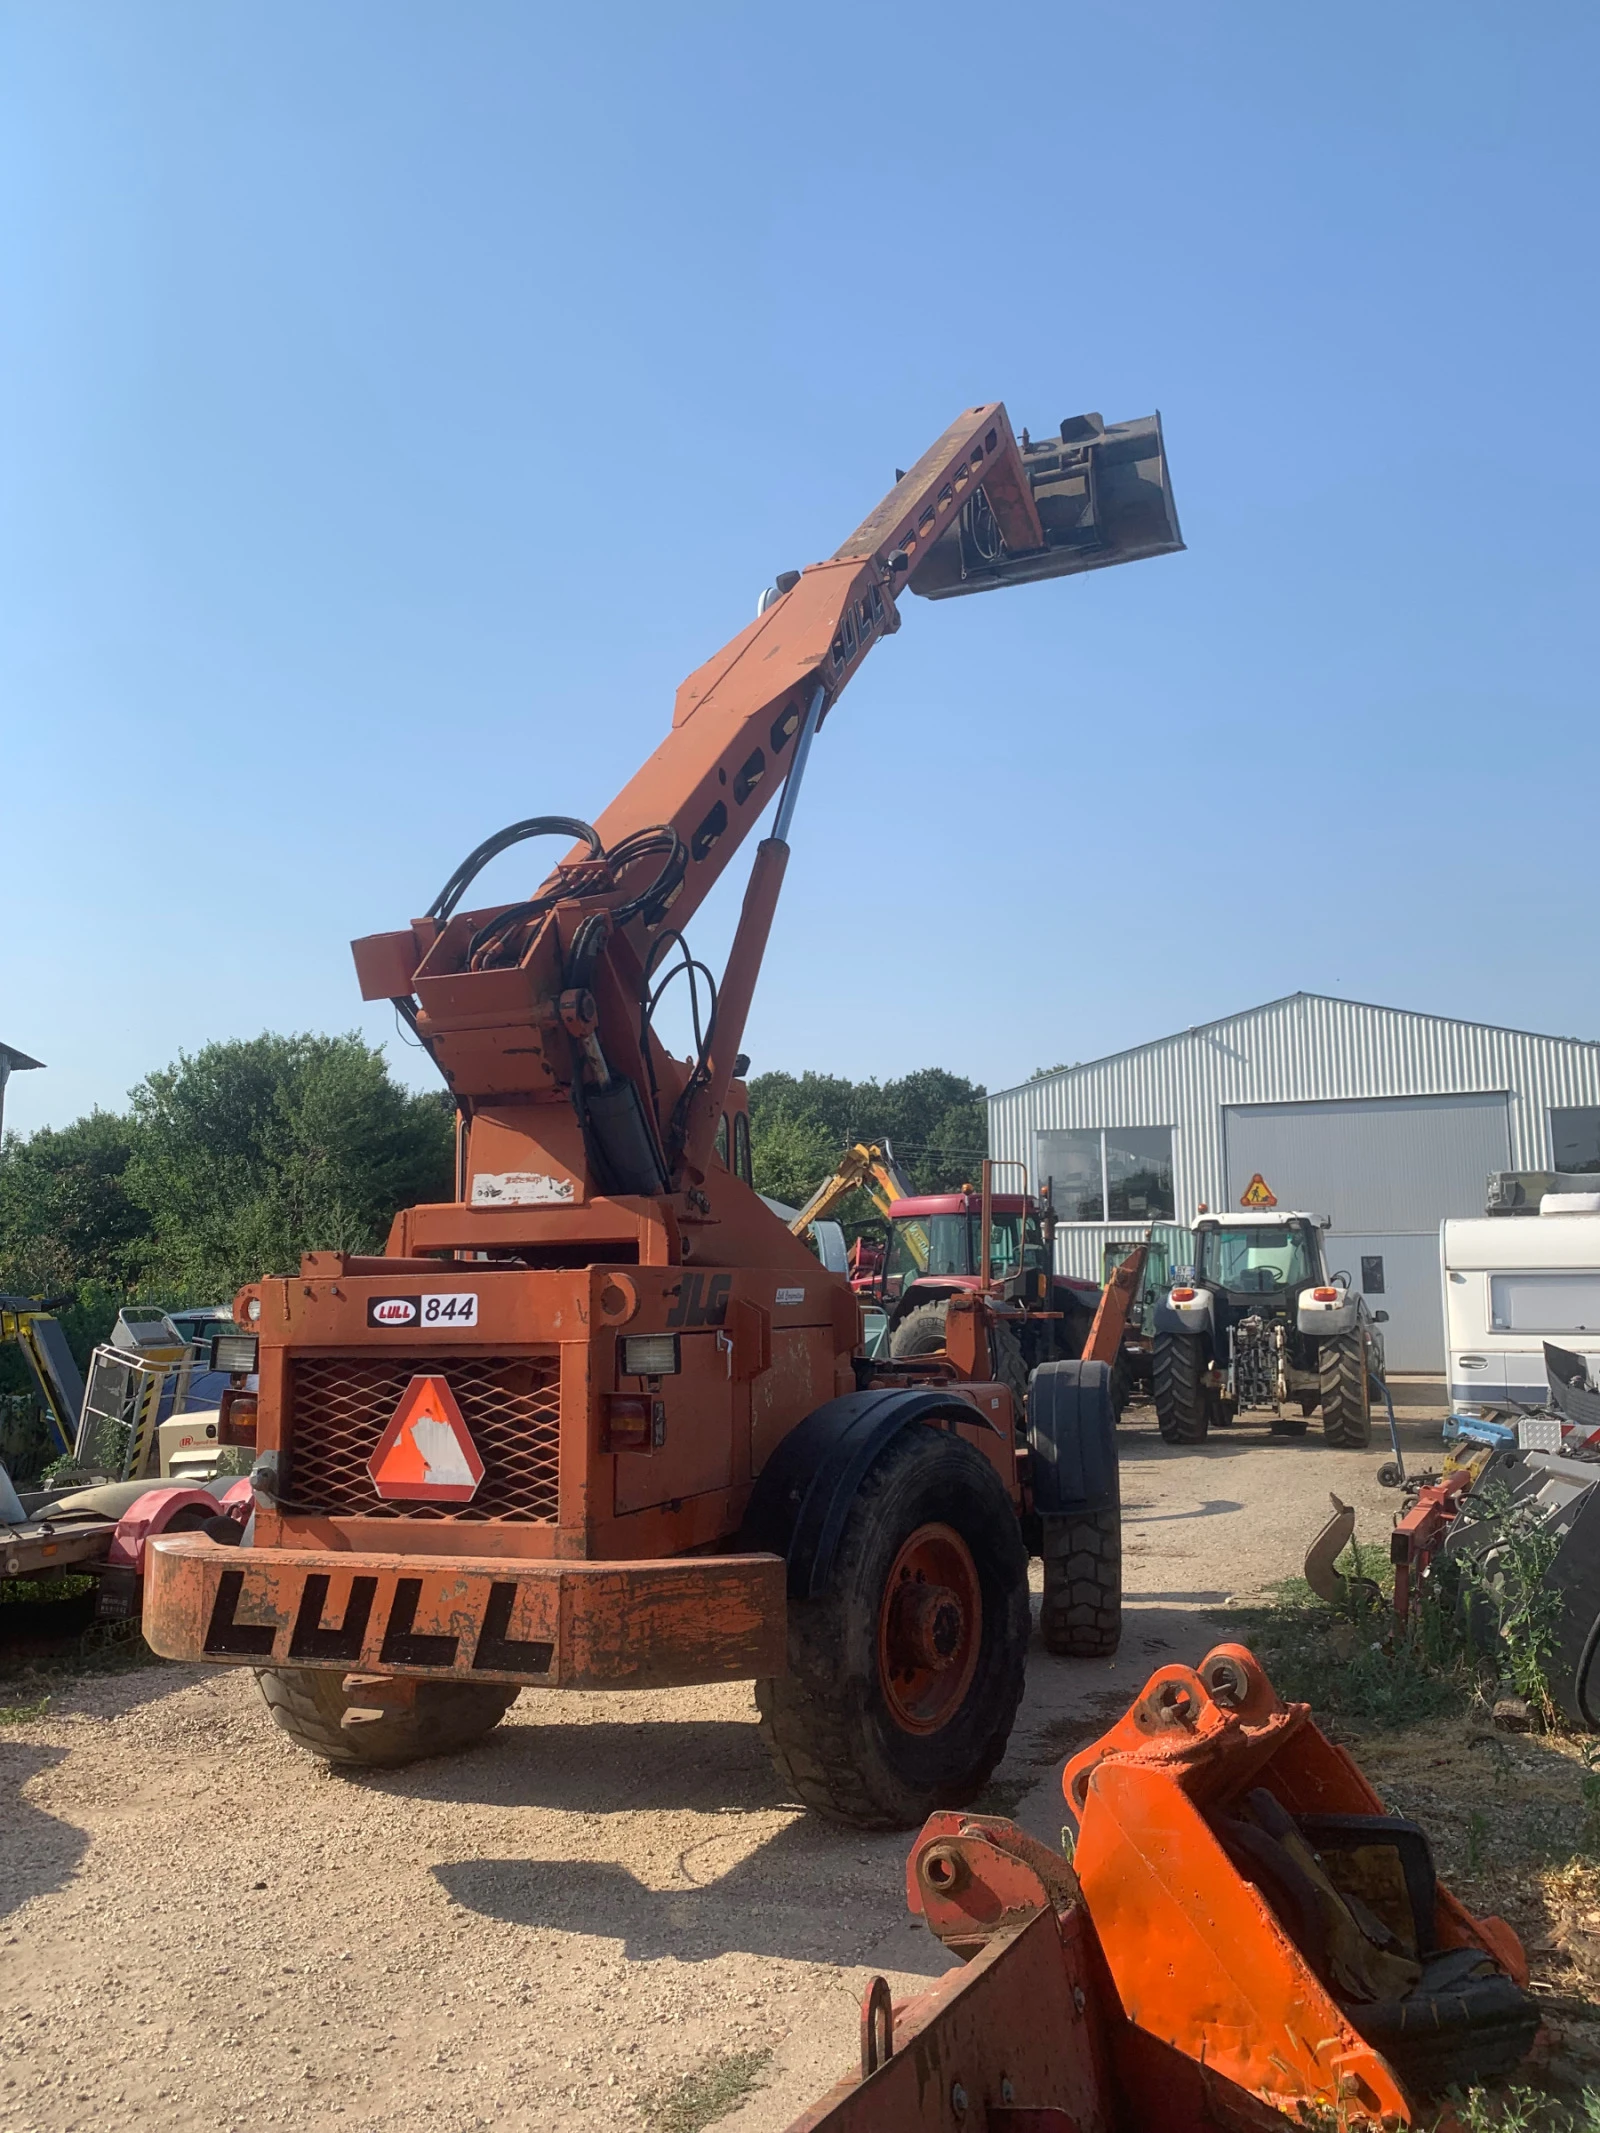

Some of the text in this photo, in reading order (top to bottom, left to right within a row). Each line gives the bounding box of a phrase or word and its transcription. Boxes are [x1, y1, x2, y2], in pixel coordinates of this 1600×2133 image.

[378, 1297, 474, 1321] LULL 844
[666, 1272, 732, 1327] JLG
[203, 1570, 555, 1674] LULL
